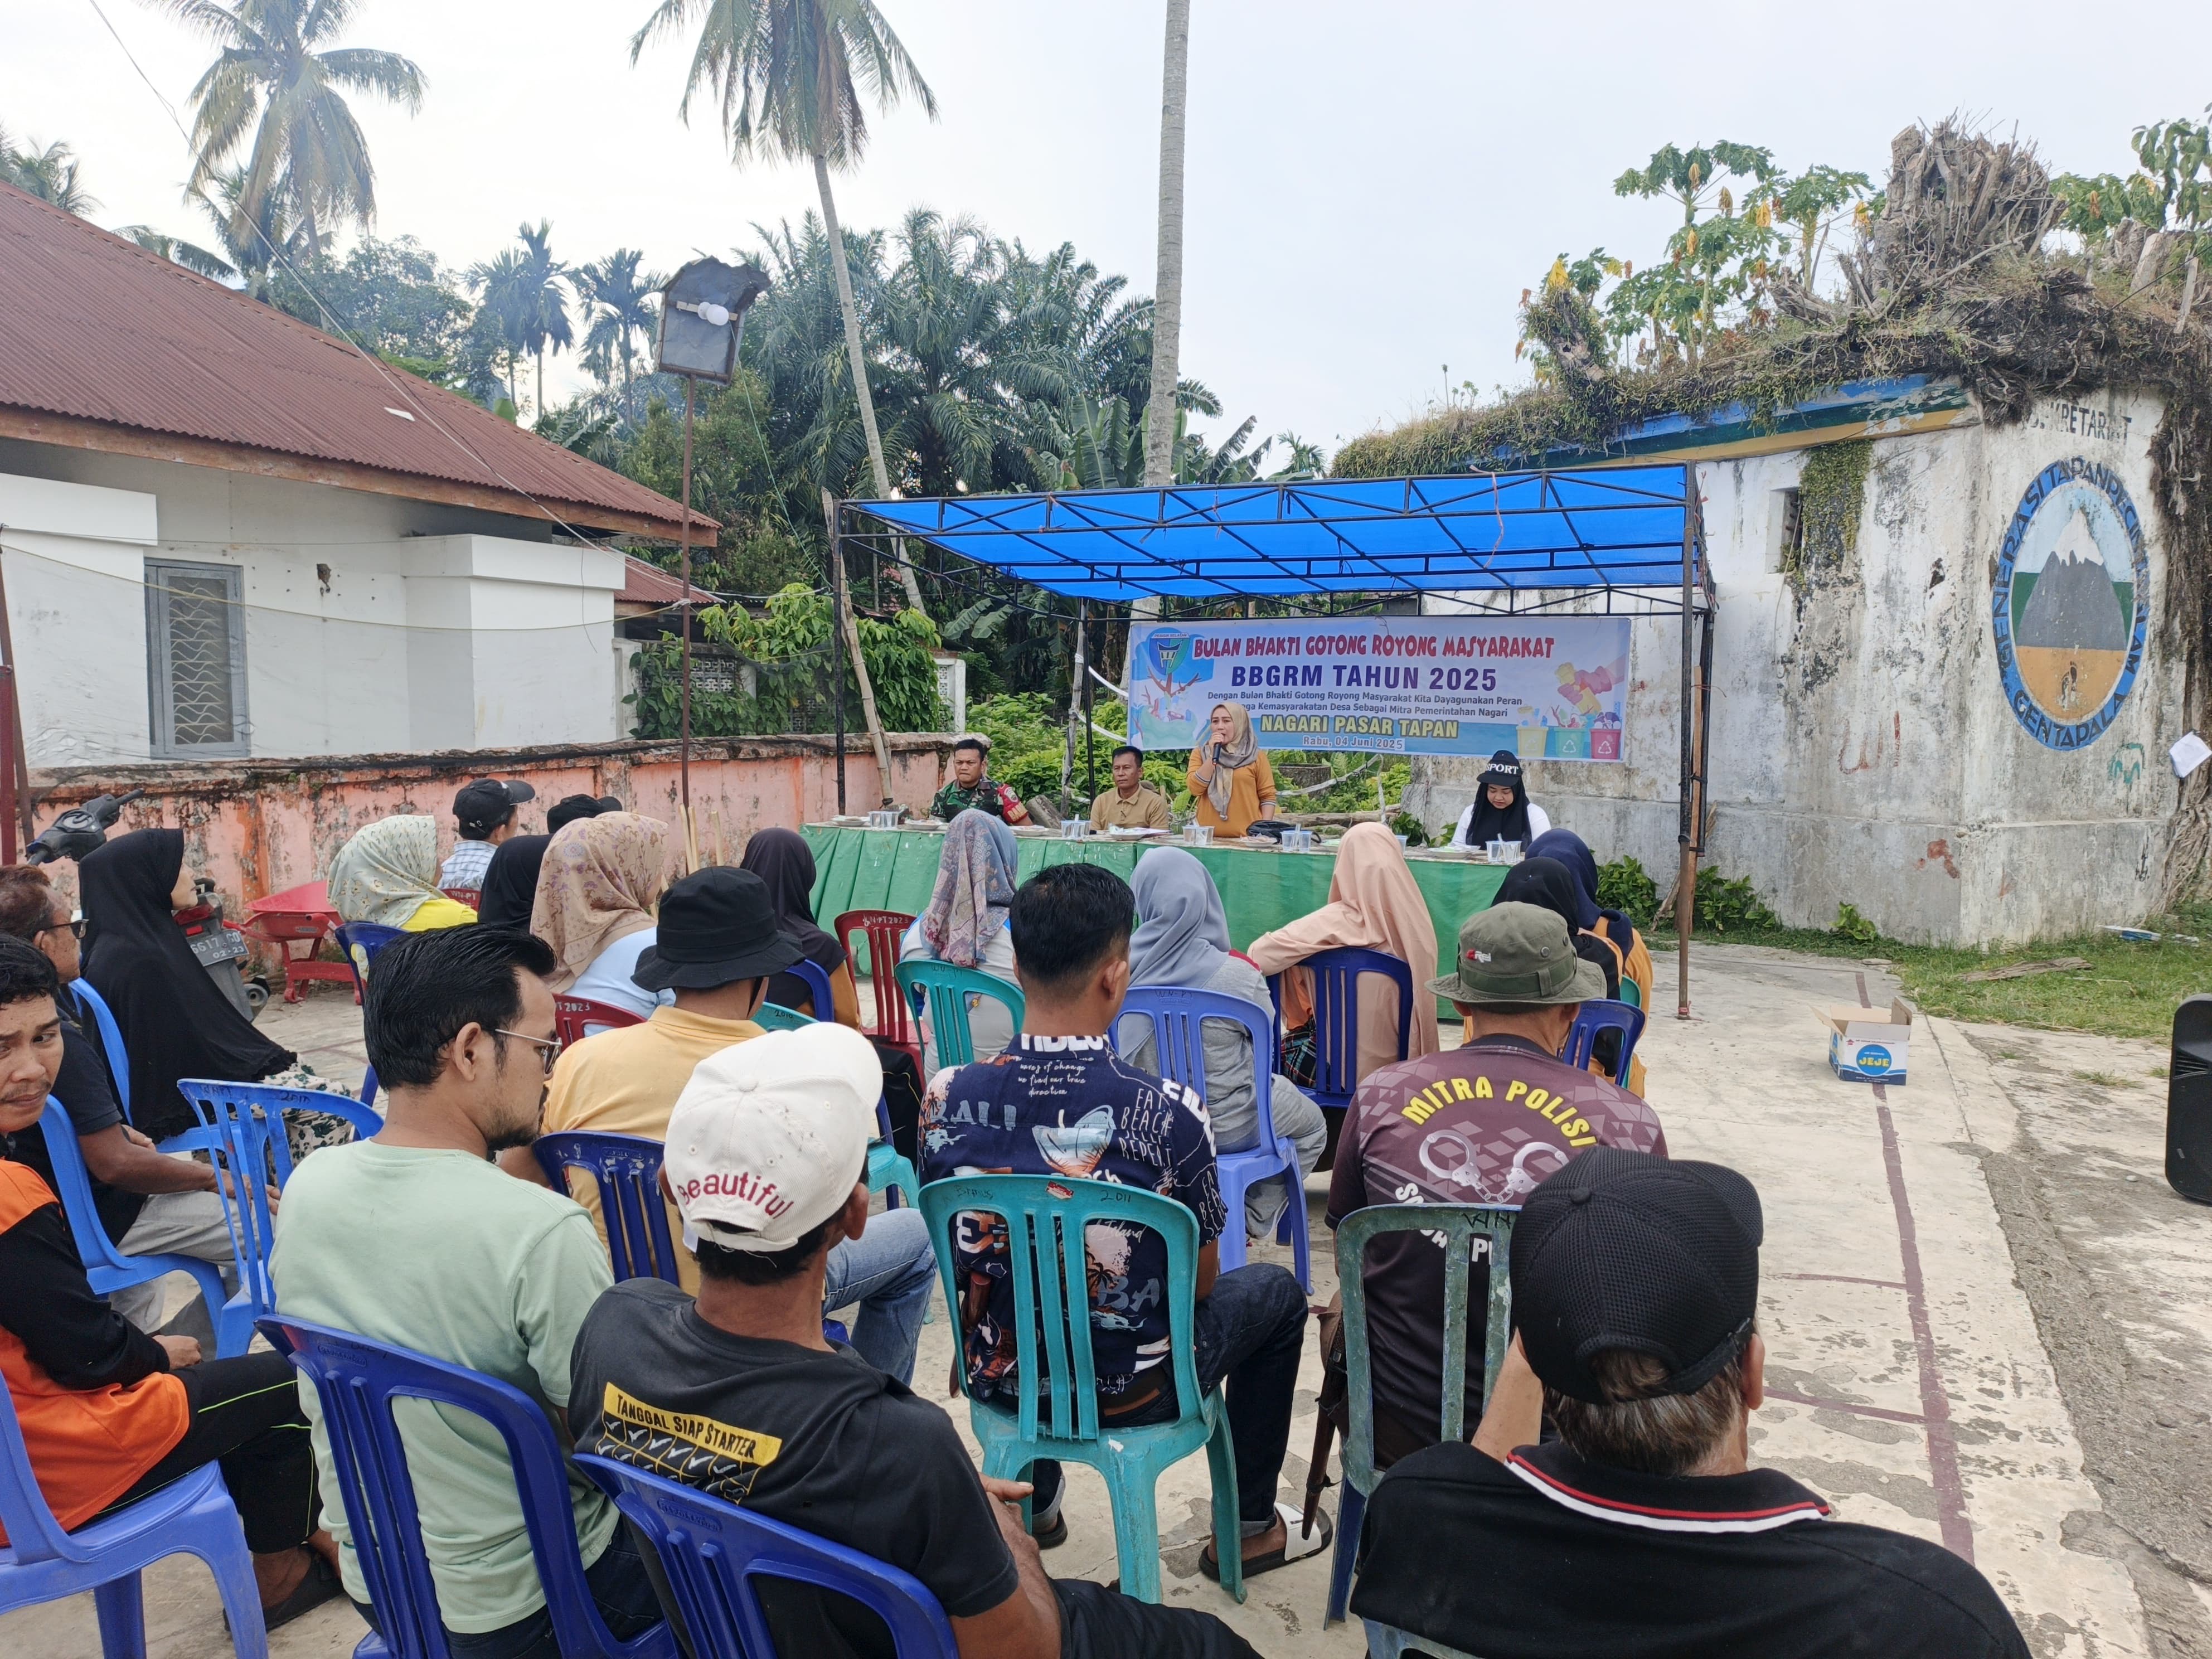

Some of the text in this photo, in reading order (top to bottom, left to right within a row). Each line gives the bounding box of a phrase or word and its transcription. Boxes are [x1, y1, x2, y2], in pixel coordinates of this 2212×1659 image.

[1194, 634, 1555, 659] BULAN BHAKTI GOTONG ROYONG MASYARAKAT
[1231, 665, 1496, 691] BBGRM TAHUN 2025
[1207, 692, 1238, 701] Dengan
[1294, 691, 1325, 701] Gotong
[1327, 692, 1360, 701] Royong
[1362, 692, 1412, 702] Masyarakat
[1434, 696, 1494, 706] Dayagunakan
[1496, 697, 1522, 705] Peran
[1258, 702, 1328, 712] Kemasyarakatan
[1353, 704, 1388, 714] Sebagai
[1414, 706, 1476, 716] Pemerintahan
[1478, 708, 1508, 718] Nagari
[1261, 715, 1459, 739] NAGARI PASAR TAPAN
[2014, 690, 2128, 747] GENTAPALA
[1303, 735, 1403, 749] Rabu, 04 Juni 2025
[1485, 763, 1519, 775] SPORT
[1859, 1057, 1890, 1067] JEJE
[1136, 1088, 1166, 1110] EAT
[1401, 1076, 1598, 1148] MITRA POLISI
[677, 1172, 794, 1220] Beautiful
[617, 1394, 757, 1459] TANGGAL SIAP STARTER
